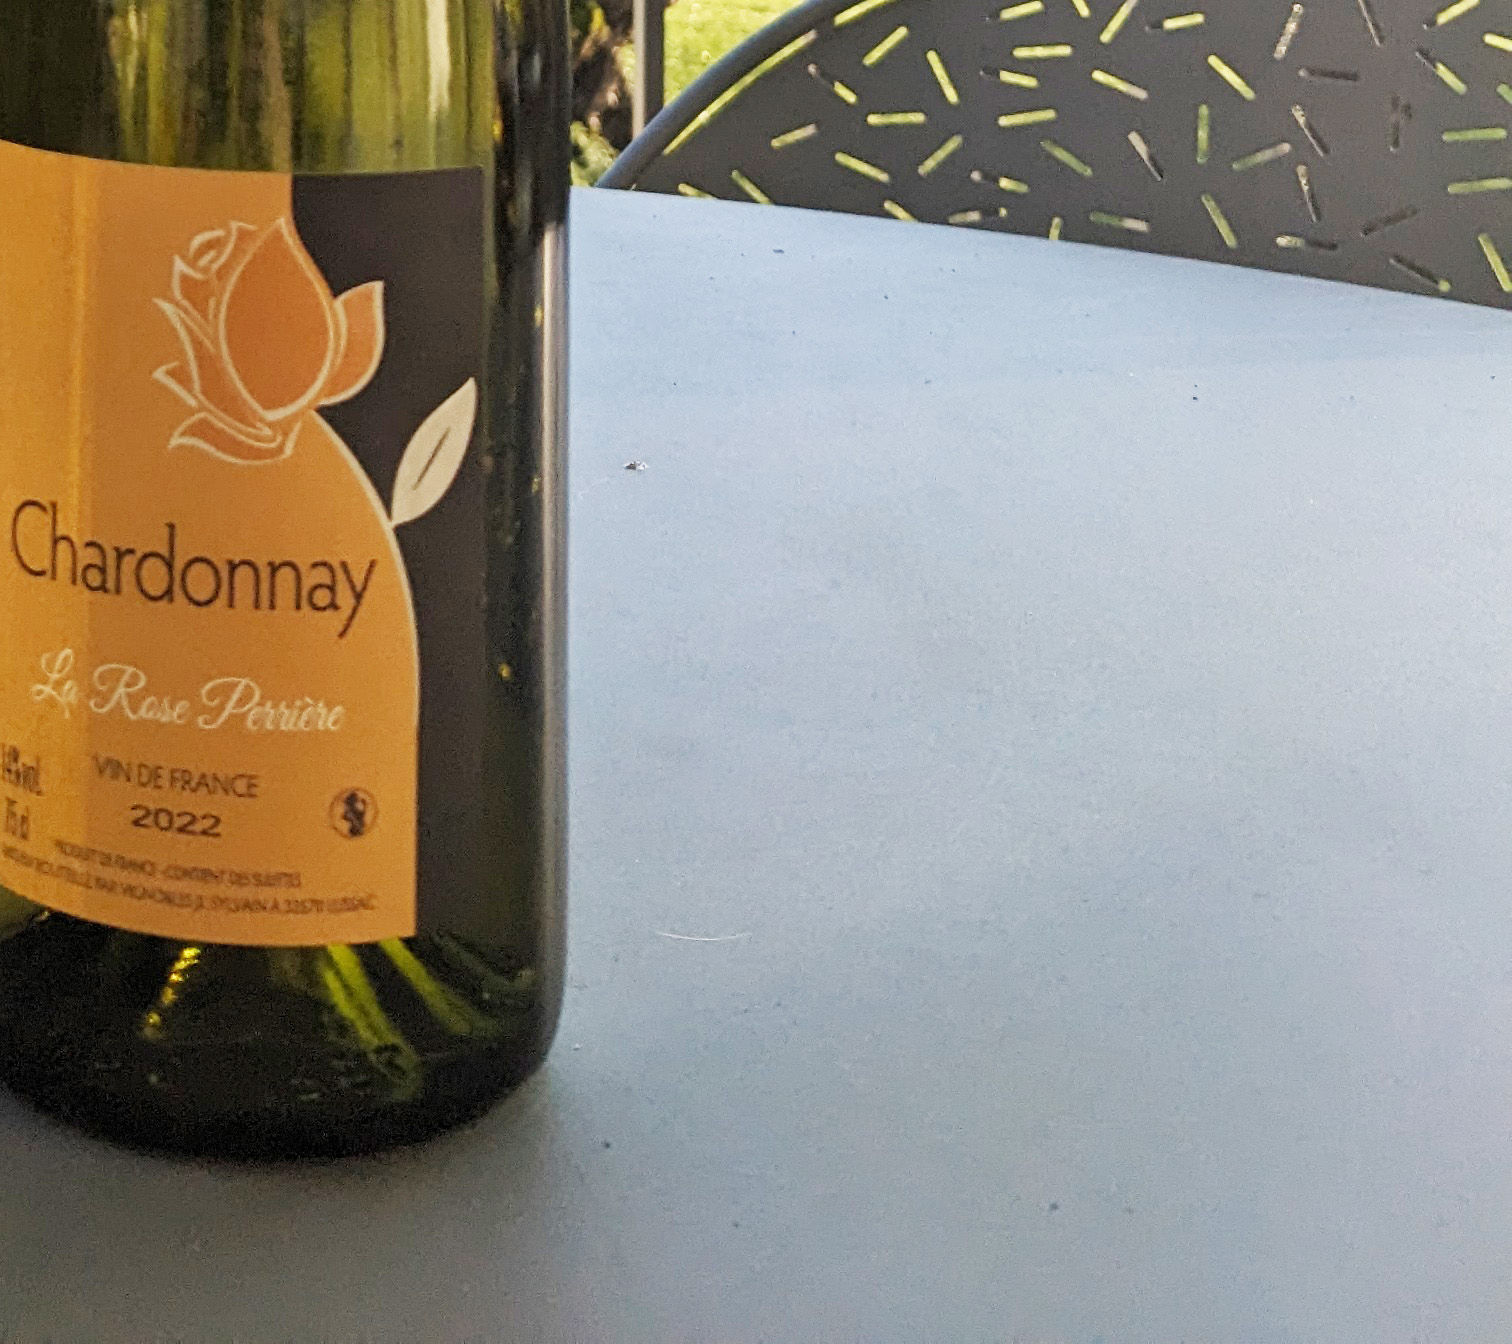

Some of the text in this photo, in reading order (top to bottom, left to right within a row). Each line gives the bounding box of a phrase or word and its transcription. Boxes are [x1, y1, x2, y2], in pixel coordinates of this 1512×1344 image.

[10, 498, 378, 640] Chardonnay
[30, 647, 347, 732] La Rose Perrière
[92, 752, 261, 799] VIN DE FRANCE
[130, 803, 222, 838] 2022
